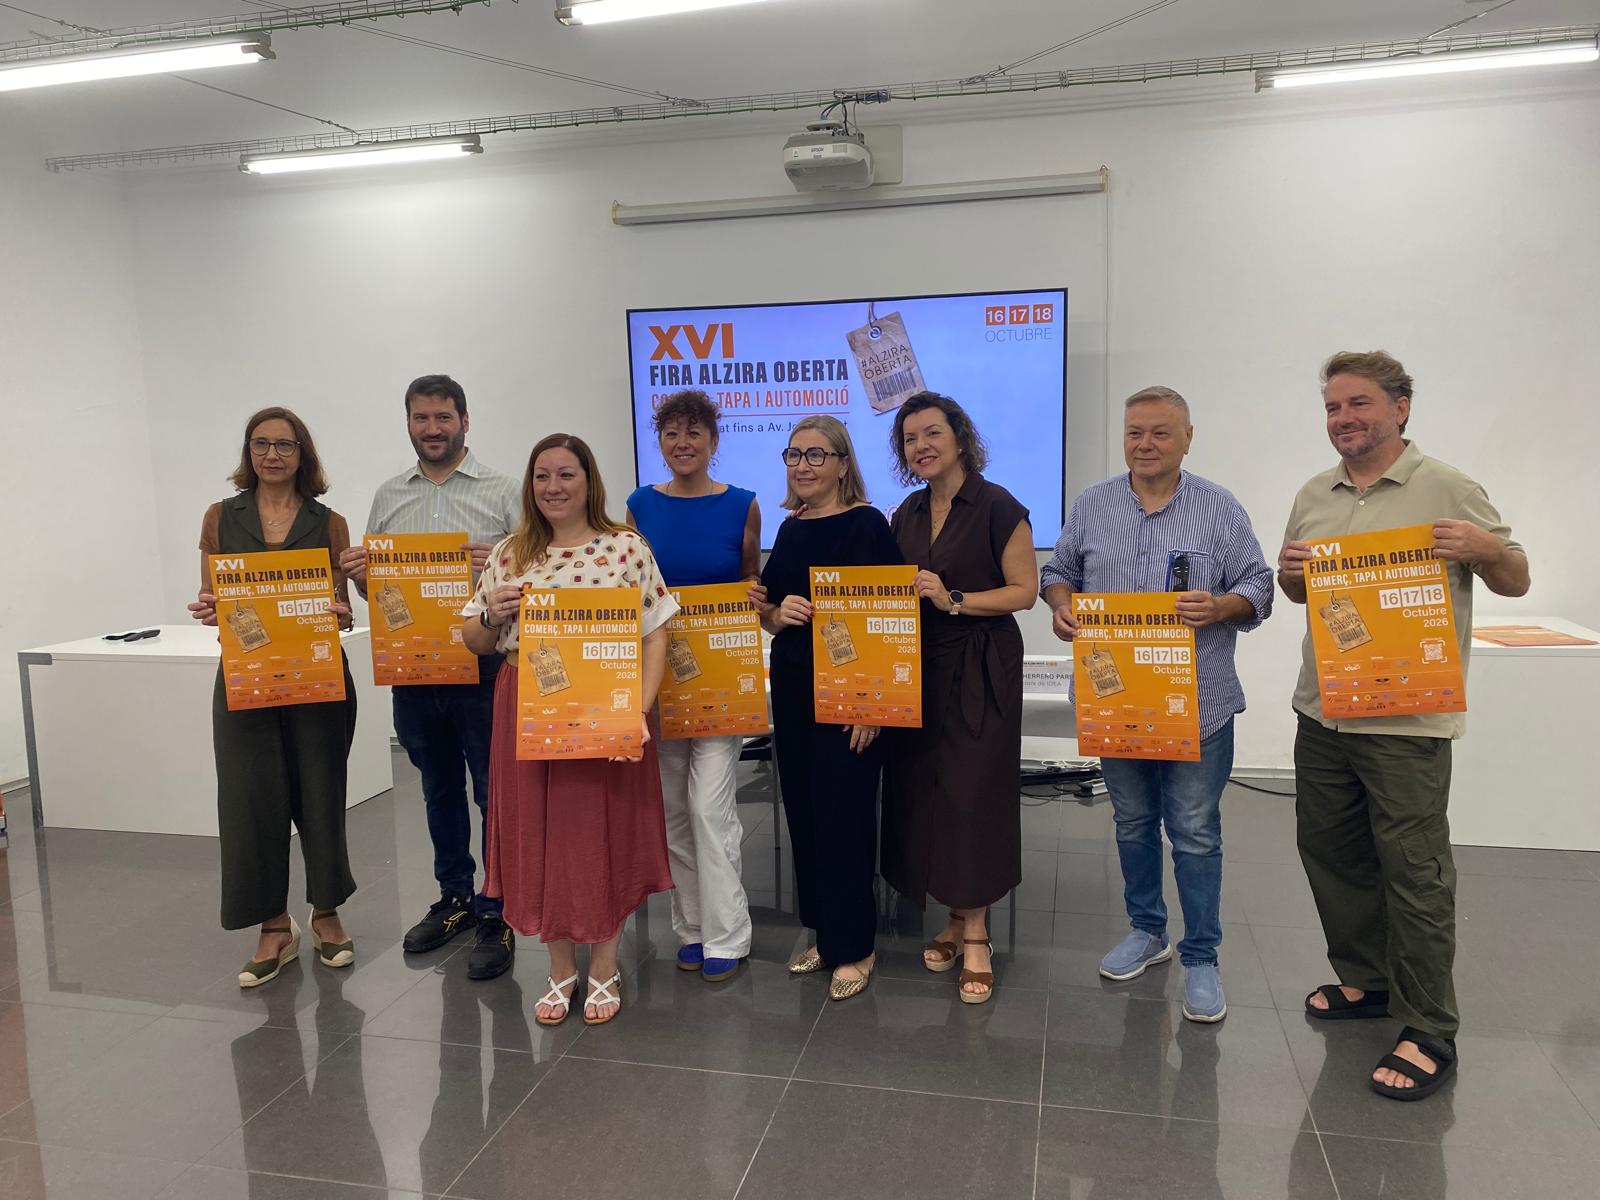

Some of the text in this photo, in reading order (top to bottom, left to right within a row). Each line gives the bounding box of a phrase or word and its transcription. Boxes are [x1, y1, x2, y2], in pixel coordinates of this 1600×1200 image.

[987, 307, 1052, 322] 16 17 18
[648, 322, 735, 361] XVI
[985, 327, 1052, 343] OCTUBRE
[861, 345, 908, 368] #ALZIRA
[650, 359, 849, 386] FIRA ALZIRA OBERTA
[864, 355, 912, 379] OBERTA
[718, 392, 751, 409] TAPA
[765, 386, 849, 408] AUTOMOCIÓ
[733, 422, 754, 433] fins
[757, 424, 764, 432] a
[769, 422, 784, 432] Av.
[368, 539, 394, 550] XVI
[1310, 542, 1341, 558] XVI
[369, 552, 466, 563] FIRA ALZIRA OBERTA
[1309, 559, 1338, 574] FIRA
[1342, 554, 1386, 570] ALZIRA
[215, 559, 244, 571] XVI
[370, 566, 400, 576] COMERÇ,
[402, 567, 420, 575] TAPA
[426, 562, 468, 575] AUTOMOCIÓ
[216, 567, 327, 584] FIRA ALZIRA OBERTA
[815, 572, 840, 583] XVI
[1311, 574, 1352, 588] COMERÇ,
[1353, 571, 1377, 582] TAPA
[1385, 562, 1441, 579] AUTOMOCIÓ
[218, 586, 254, 597] COMERÇ,
[256, 584, 277, 593] TAPA
[283, 581, 329, 592] AUTOMOCIÓ
[423, 585, 468, 595] 16 17 18
[815, 586, 915, 596] FIRA ALZIRA OBERTA
[525, 593, 555, 606] XVI
[1382, 588, 1443, 605] 16 17 18
[280, 601, 329, 614] 16 17 18
[681, 601, 756, 616] ALZIRA OBERTA
[815, 600, 847, 611] COMERÇ,
[849, 600, 866, 609] TAPA
[873, 596, 915, 609] AUTOMOCIÓ
[1076, 598, 1104, 611] XVI
[525, 608, 637, 621] FIRA ALZIRA OBERTA
[1403, 607, 1447, 618] Octubre
[666, 620, 687, 630] MERÇ,
[690, 619, 707, 627] TAPA
[714, 614, 756, 625] AUTOMOCIÓ
[1077, 614, 1185, 625] FIRA ALZIRA OBERT
[1330, 619, 1361, 633] OBERTA
[1423, 618, 1449, 628] 2026
[314, 624, 334, 632] 2026
[525, 623, 561, 636] COMERÇ,
[564, 625, 583, 634] TAPA
[591, 619, 637, 634] AUTOMOCIÓ
[869, 621, 914, 632] 16 17 18
[1114, 629, 1133, 638] TAPA
[1141, 627, 1190, 638] AUTOMOCIÓ
[710, 635, 756, 646] 16 17 18
[883, 635, 916, 644] Octubre
[585, 646, 635, 656] 16 17 18
[726, 649, 758, 657] Octubre
[898, 646, 916, 654] 2026
[1137, 651, 1189, 661] 16 17 18
[536, 666, 563, 677] OBERTA
[616, 671, 637, 679] 2026
[1153, 666, 1191, 674] Octubre
